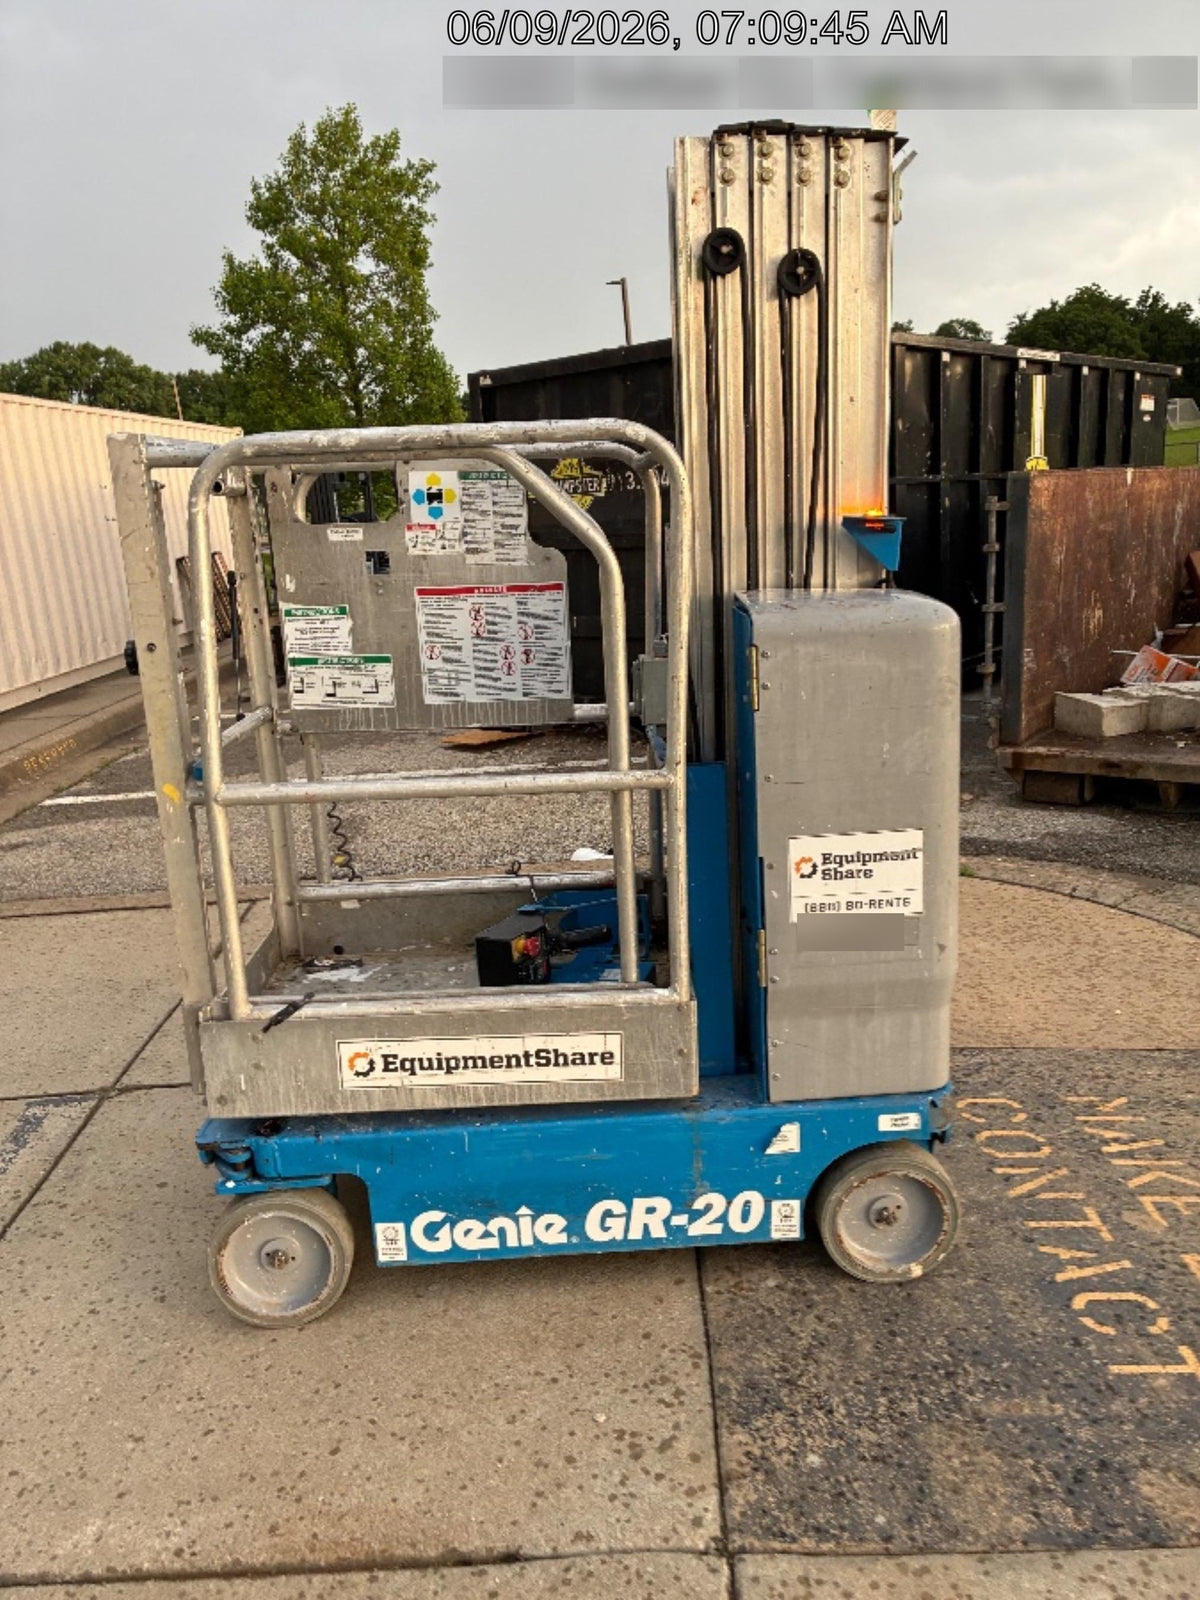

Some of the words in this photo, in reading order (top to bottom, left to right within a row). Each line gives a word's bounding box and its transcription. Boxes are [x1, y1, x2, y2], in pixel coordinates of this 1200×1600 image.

[821, 848, 920, 867] Equipment
[821, 867, 874, 881] Share
[381, 1048, 614, 1076] EquipmentShare
[585, 1190, 765, 1242] GR-20
[956, 1097, 1200, 1378] CONTACT
